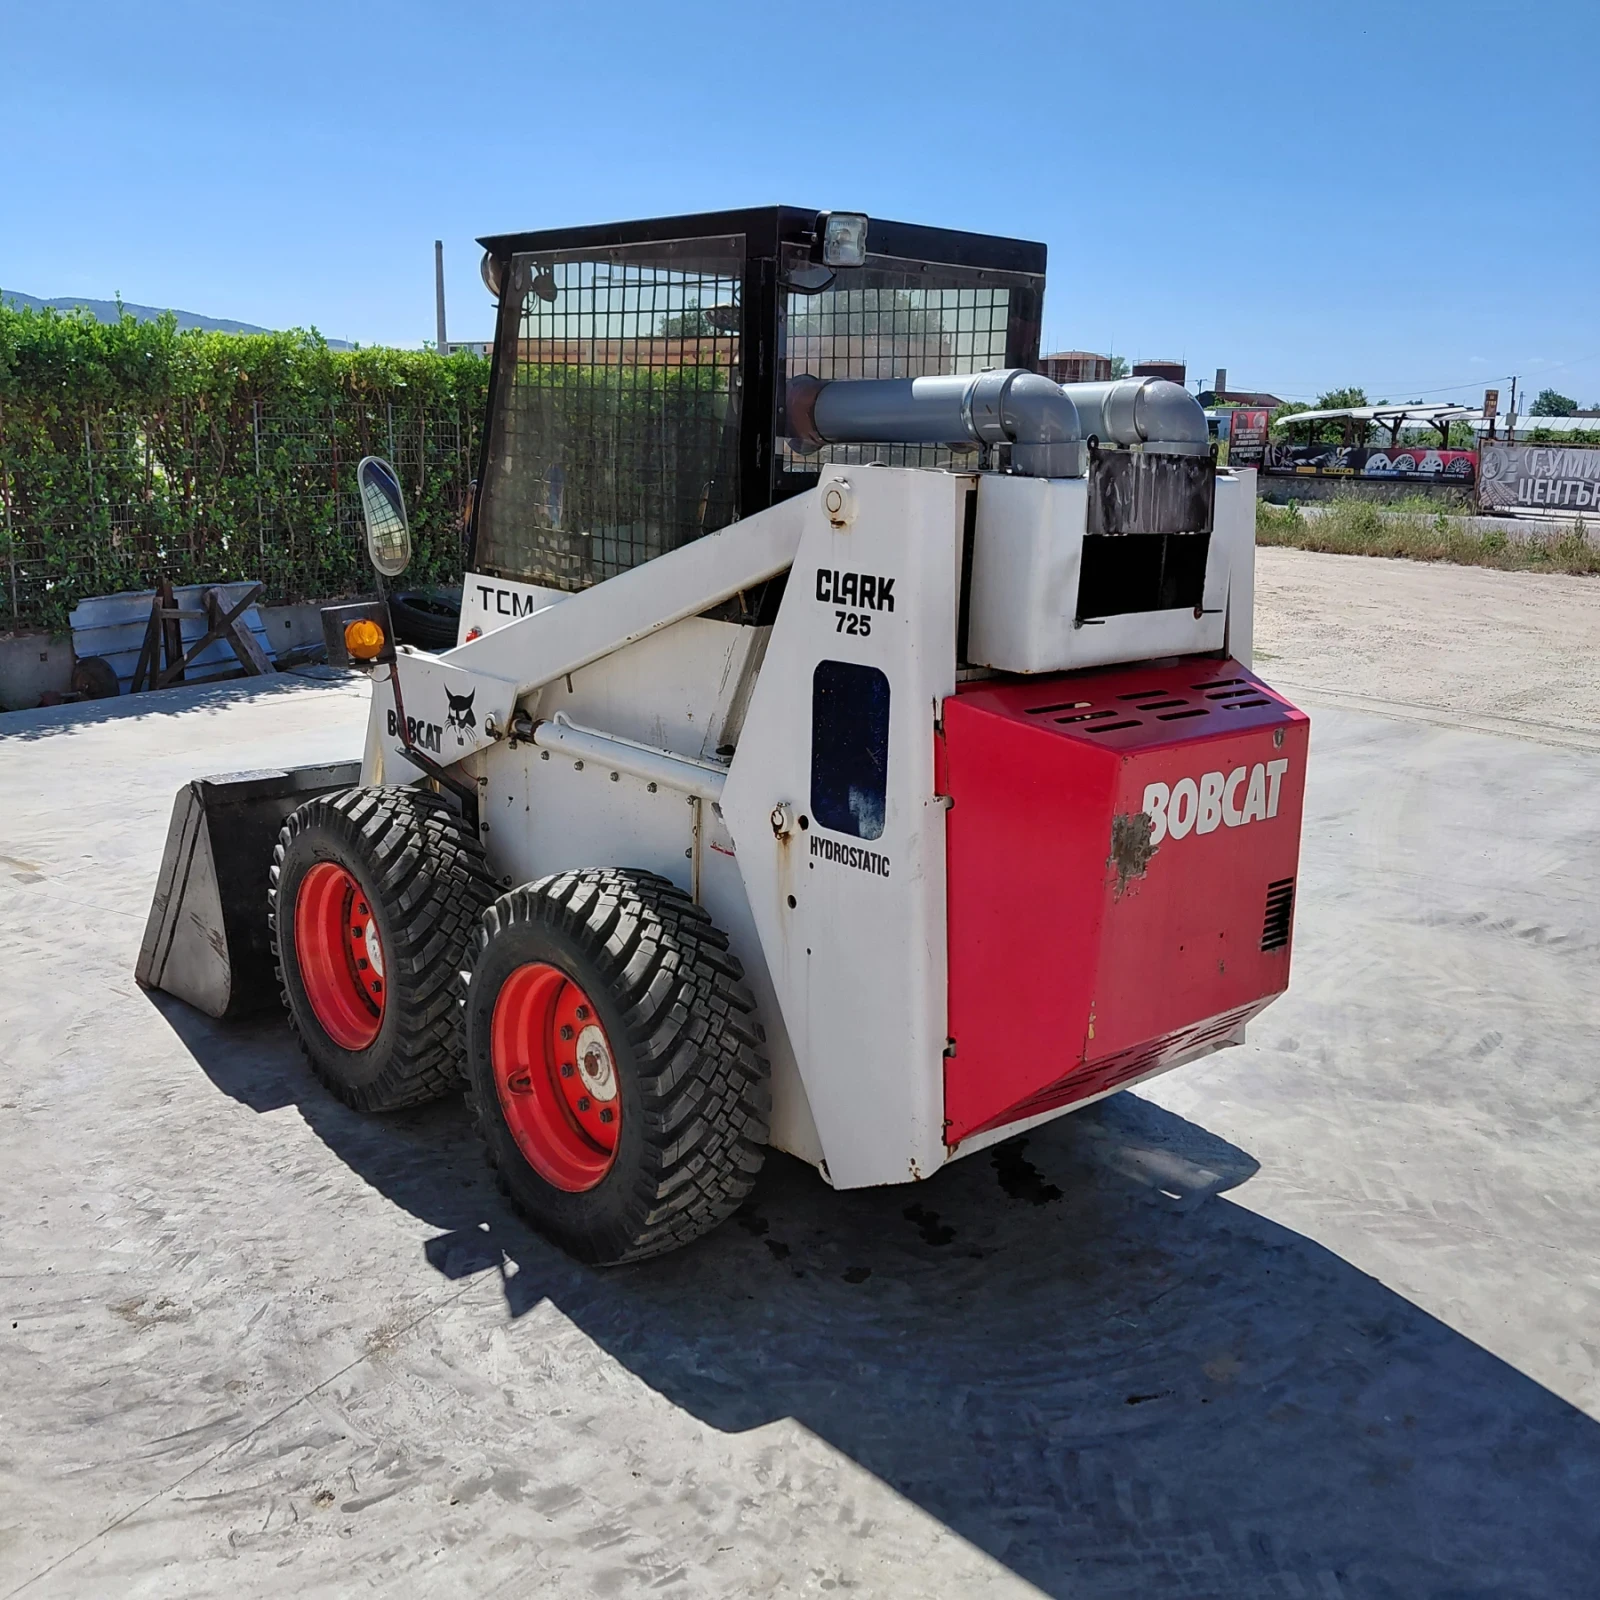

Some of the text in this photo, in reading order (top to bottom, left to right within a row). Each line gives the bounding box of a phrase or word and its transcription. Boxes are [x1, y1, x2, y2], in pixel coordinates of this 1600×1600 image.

[476, 585, 534, 618] TCM
[816, 568, 896, 613] CLARK
[835, 610, 872, 637] 725
[1142, 758, 1289, 846] BOBCAT
[810, 835, 891, 878] HYDROSTATIC
